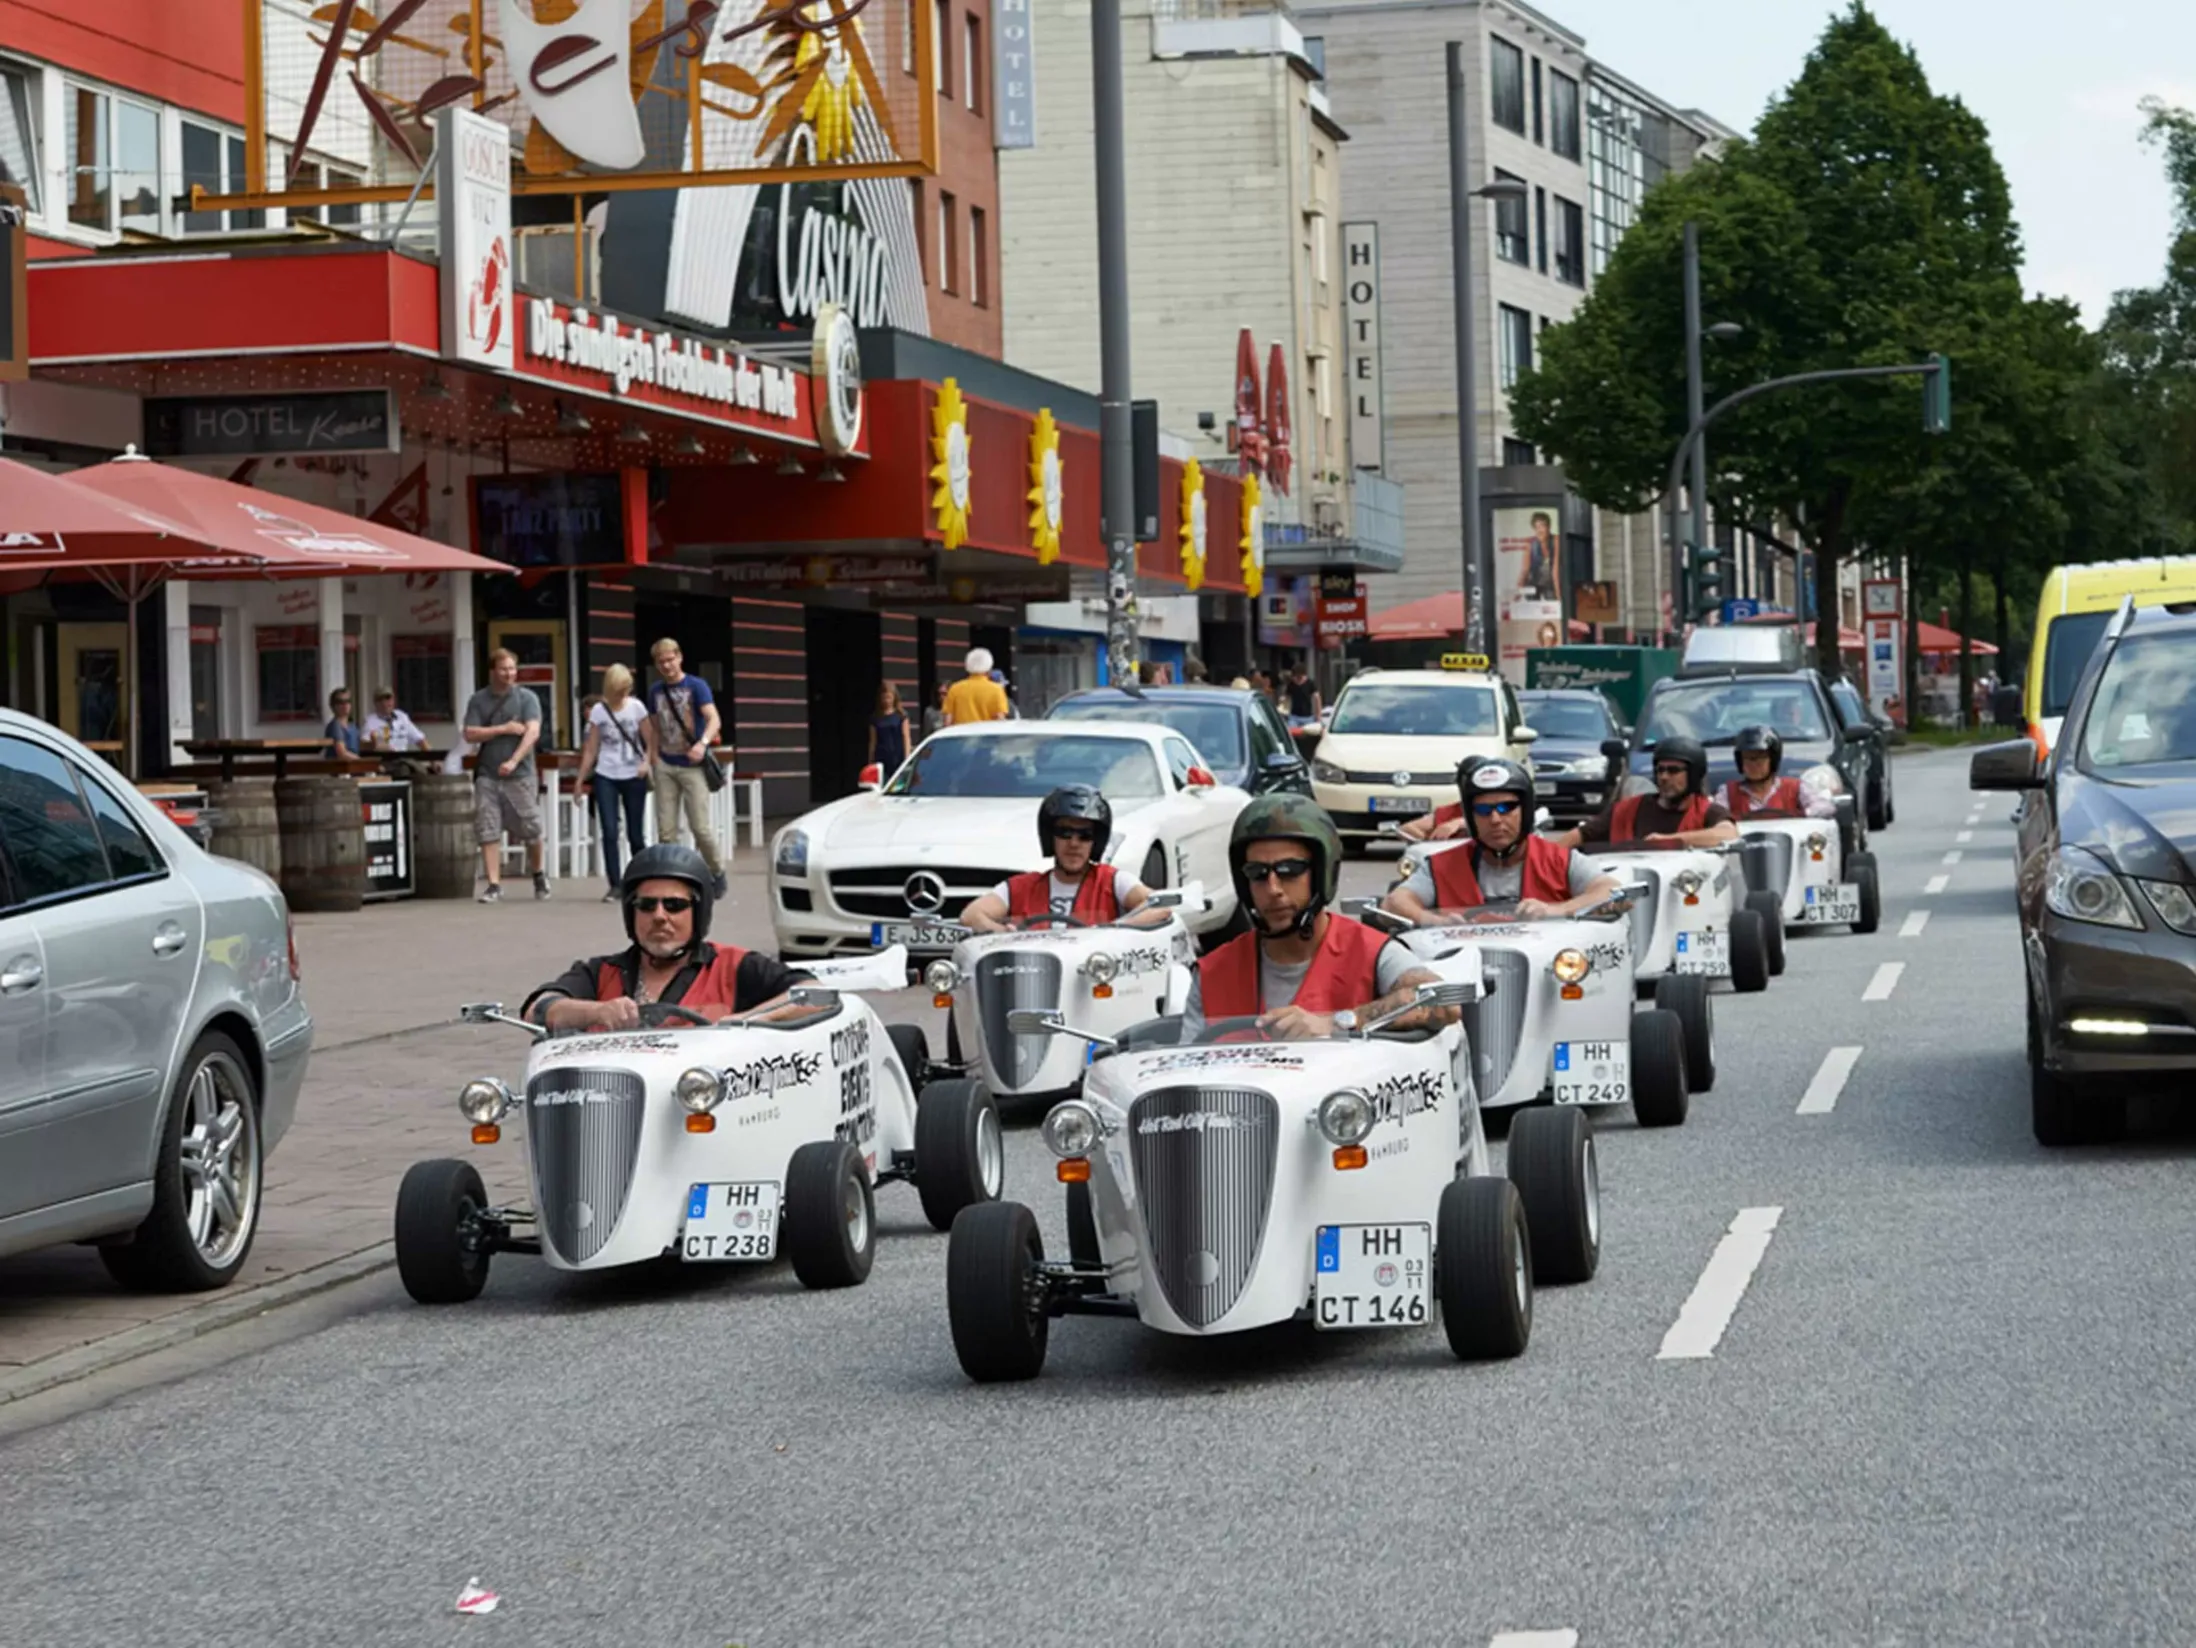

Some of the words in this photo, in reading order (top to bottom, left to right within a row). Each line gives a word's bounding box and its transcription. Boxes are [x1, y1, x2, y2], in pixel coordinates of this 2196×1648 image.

[1002, 0, 1025, 127] HOTEL
[778, 122, 887, 328] Casino
[1351, 243, 1374, 418] HOTEL
[530, 297, 566, 363] Die
[736, 353, 761, 410] der
[761, 363, 797, 420] Welt
[194, 406, 303, 437] HOTEL
[1320, 619, 1366, 635] KIOSK
[1818, 888, 1838, 903] HH
[1807, 905, 1826, 922] CT
[1831, 903, 1858, 921] 307
[887, 926, 899, 944] E
[909, 926, 931, 944] JS
[1584, 1043, 1611, 1061] HH
[1557, 1085, 1584, 1103] CT
[1588, 1083, 1626, 1102] 249
[726, 1185, 760, 1206] HH
[687, 1236, 718, 1257] CT
[724, 1235, 770, 1256] 238
[1362, 1228, 1402, 1256] HH
[1323, 1254, 1334, 1268] D
[1405, 1260, 1423, 1271] 03
[1321, 1297, 1360, 1324] CT
[1369, 1294, 1425, 1323] 146
